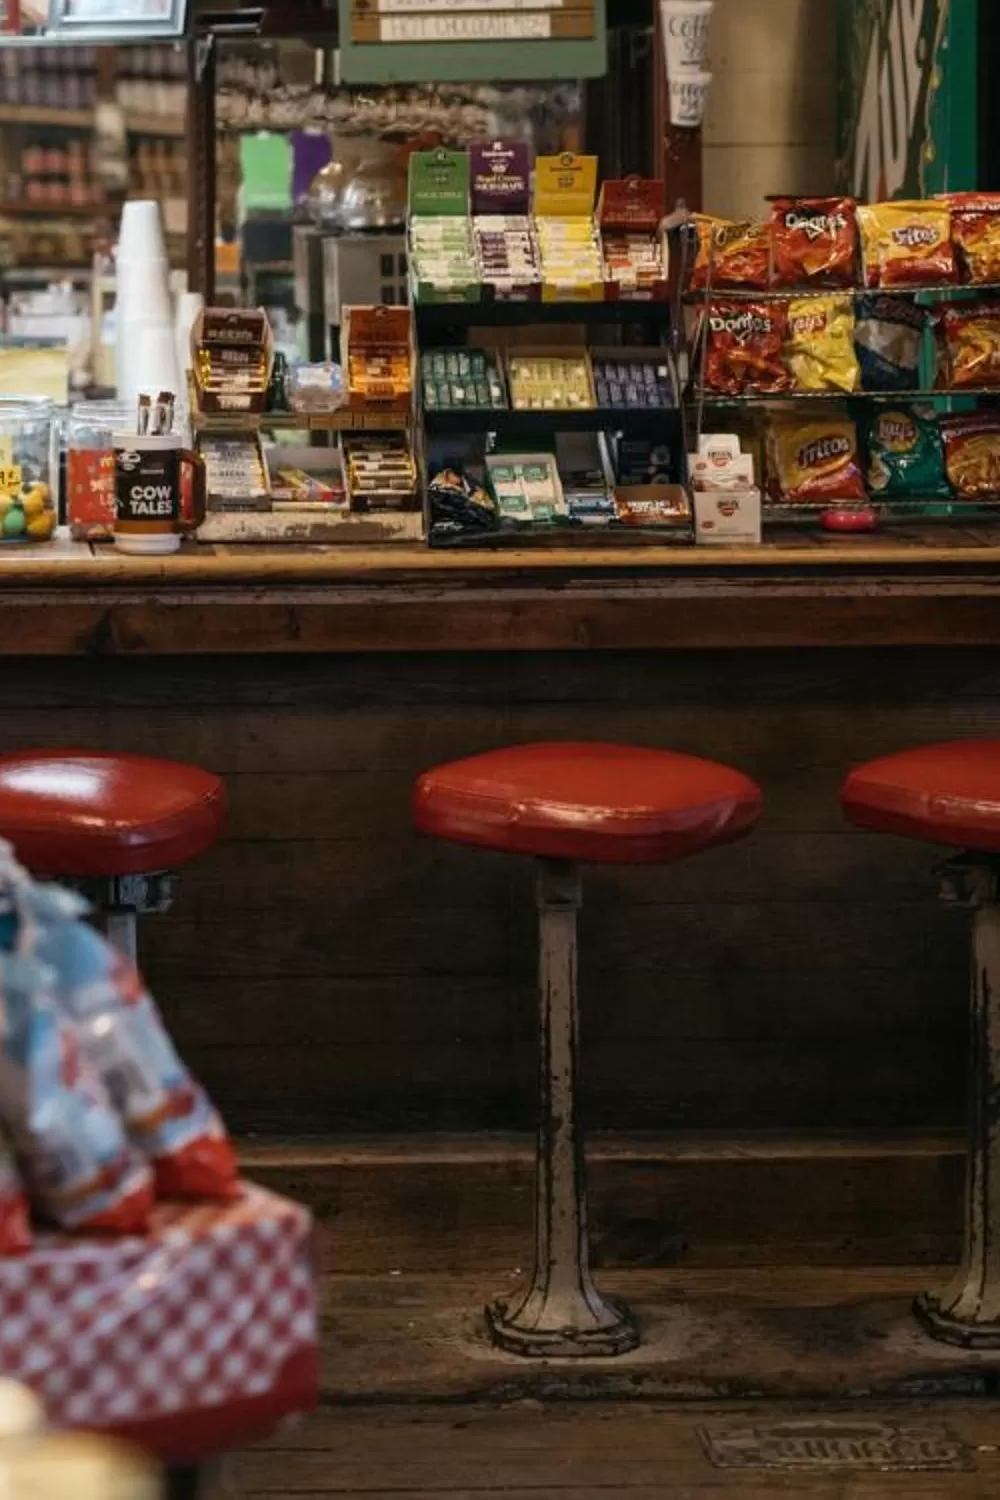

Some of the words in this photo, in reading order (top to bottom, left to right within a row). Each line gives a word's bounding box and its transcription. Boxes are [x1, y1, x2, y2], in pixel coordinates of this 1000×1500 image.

[710, 313, 772, 334] Doritos
[800, 436, 849, 468] Fritos
[131, 485, 173, 501] COW
[129, 500, 174, 516] TALES
